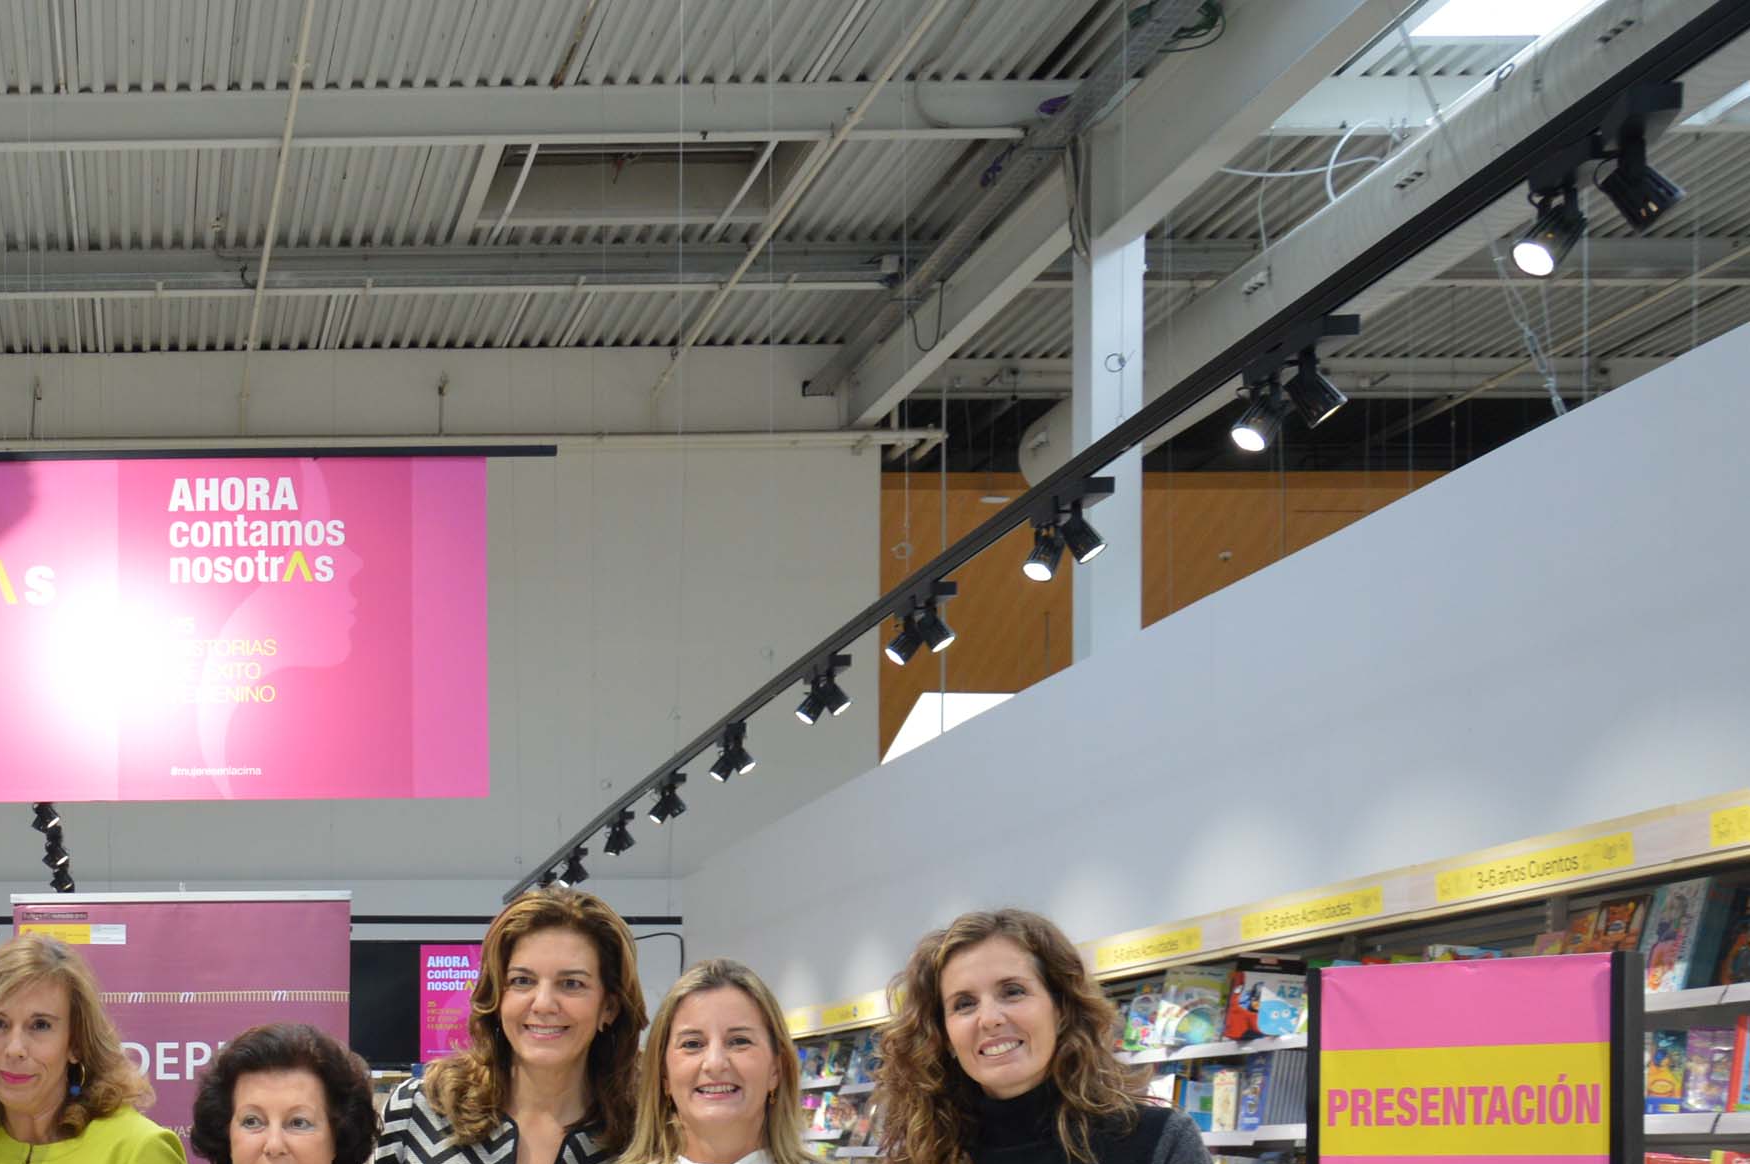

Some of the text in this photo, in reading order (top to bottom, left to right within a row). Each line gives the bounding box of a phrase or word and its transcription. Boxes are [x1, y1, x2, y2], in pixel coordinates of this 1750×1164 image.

[168, 477, 298, 511] AHORA
[169, 514, 345, 548] contamos
[1476, 852, 1580, 889] 3-6 años Cuentos
[427, 956, 469, 967] AHORA
[1327, 1074, 1600, 1126] PRESENTACIÓN
